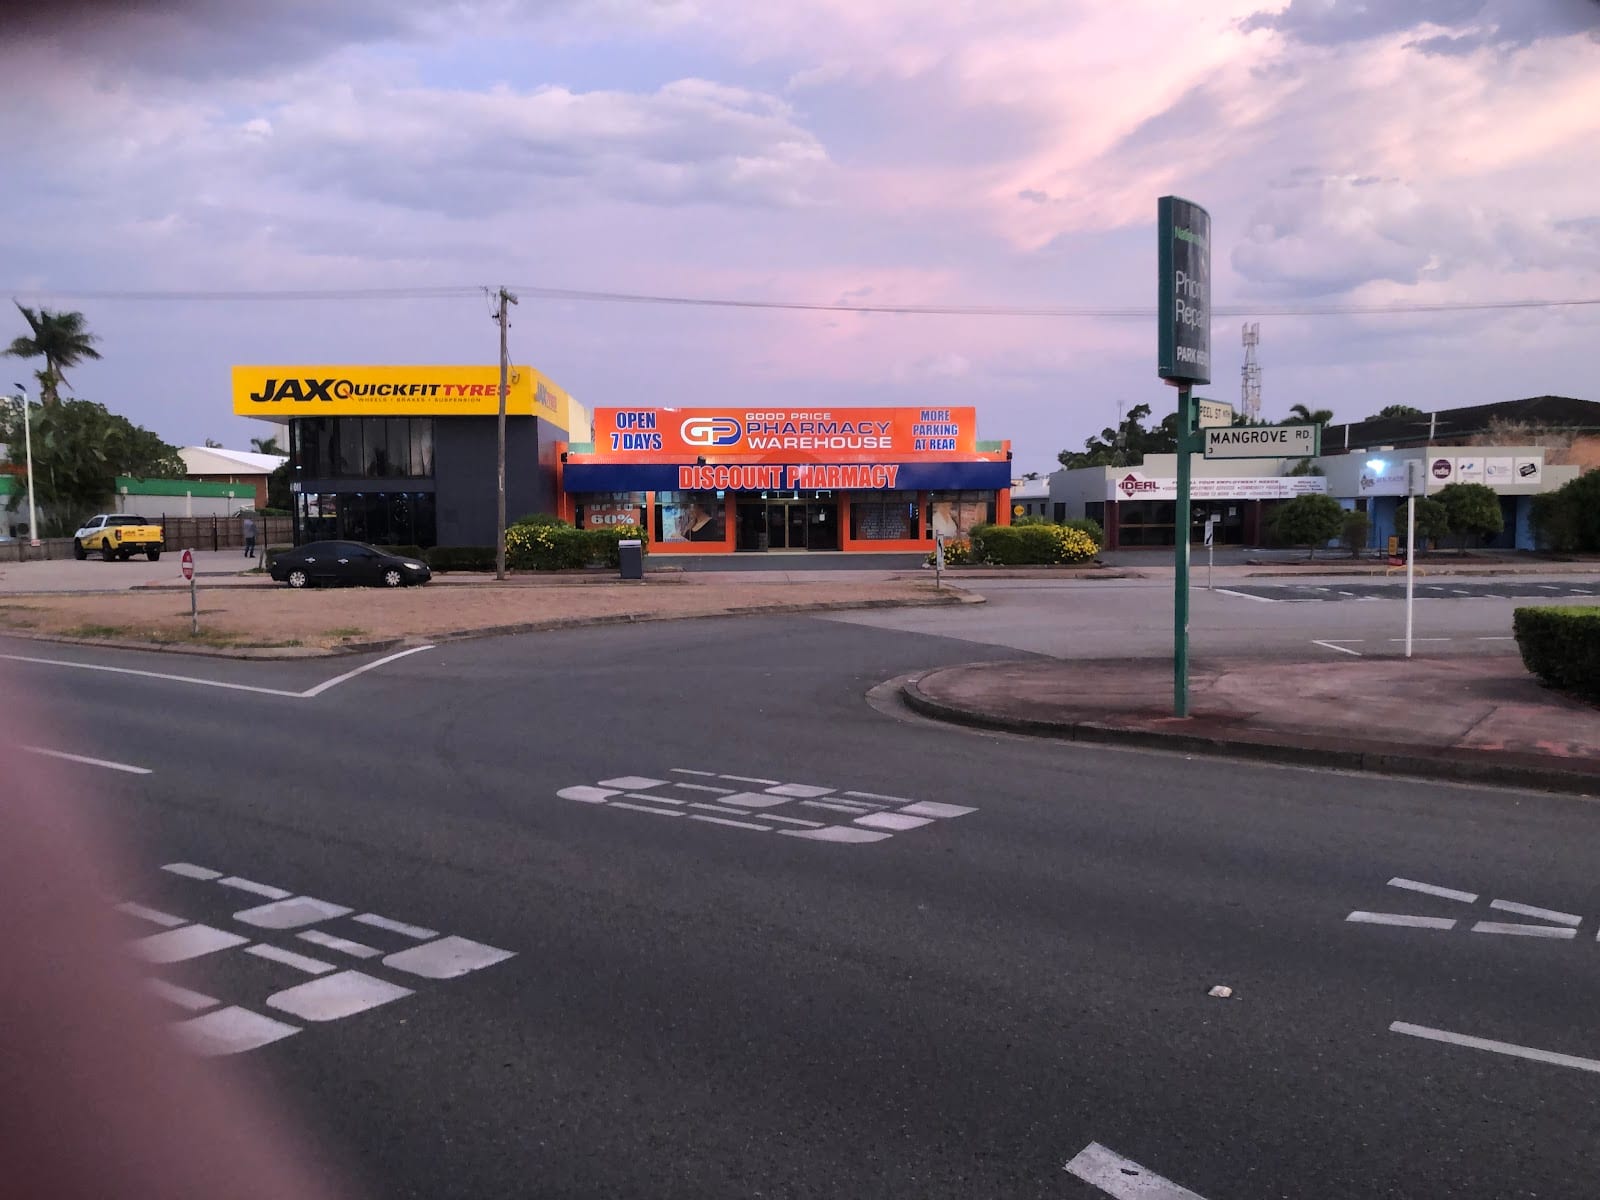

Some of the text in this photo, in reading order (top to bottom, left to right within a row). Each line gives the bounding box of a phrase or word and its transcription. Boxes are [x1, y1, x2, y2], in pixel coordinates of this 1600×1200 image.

[249, 379, 336, 402] JAX
[616, 411, 656, 430] OPEN
[745, 412, 832, 421] GOOD PRICE
[919, 410, 951, 422] MORE
[680, 417, 742, 446] GP
[745, 421, 892, 435] PHARMACY
[911, 424, 959, 437] PARKING
[610, 432, 662, 451] 7 DAYS
[747, 436, 893, 450] WAREHOUSE
[914, 438, 956, 451] AT REAR
[1210, 430, 1287, 445] MANGROVE
[679, 464, 900, 489] DISCOUNT PHARMACY
[1121, 481, 1160, 490] IDEAL
[590, 514, 635, 525] 60%
